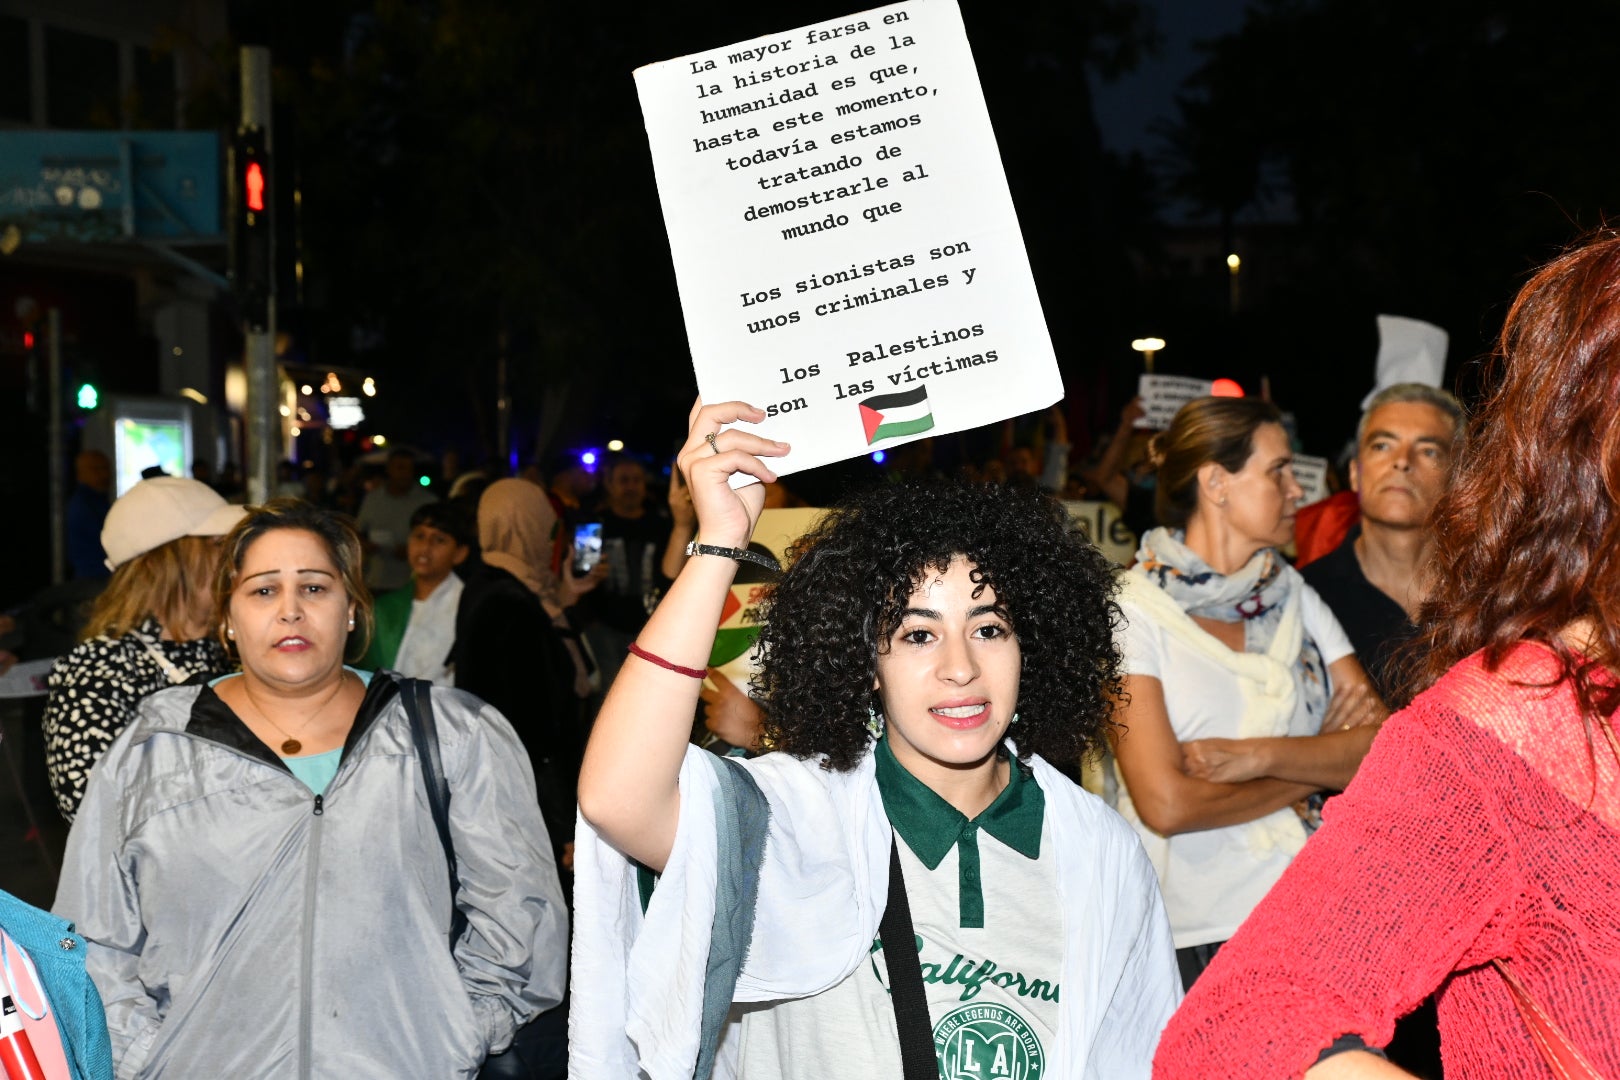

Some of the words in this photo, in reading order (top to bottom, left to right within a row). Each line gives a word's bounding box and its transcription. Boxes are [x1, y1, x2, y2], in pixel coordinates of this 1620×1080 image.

[690, 60, 717, 75] La
[728, 38, 793, 66] mayor
[806, 19, 870, 45] farsa
[883, 9, 909, 25] en
[697, 83, 722, 99] la
[733, 53, 838, 90] historia
[850, 44, 875, 60] de
[889, 34, 916, 50] la
[693, 129, 760, 153] hasta
[772, 111, 824, 133] este
[836, 86, 938, 118] momento,
[700, 83, 818, 125] humanidad
[831, 76, 856, 91] es
[869, 63, 918, 85] que,
[726, 139, 818, 171] todavía
[830, 112, 921, 145] estamos
[758, 157, 862, 191] tratando
[876, 145, 902, 161] de
[743, 177, 889, 222] demostrarle
[903, 164, 929, 183] al
[781, 214, 848, 241] mundo
[863, 201, 902, 223] que
[741, 286, 782, 308] Los
[795, 253, 915, 294] sionistas
[930, 241, 971, 261] son
[747, 311, 801, 334] unos
[814, 275, 949, 317] criminales
[962, 267, 977, 285] y
[766, 397, 808, 417] son
[834, 379, 874, 400] las
[888, 350, 999, 386] víctimas
[780, 363, 820, 384] los
[847, 323, 985, 368] Palestinos
[936, 1017, 960, 1045] WHERE
[960, 1008, 1003, 1022] LEGENDS
[1004, 1015, 1022, 1032] ARE
[1020, 1031, 1039, 1057] BORN
